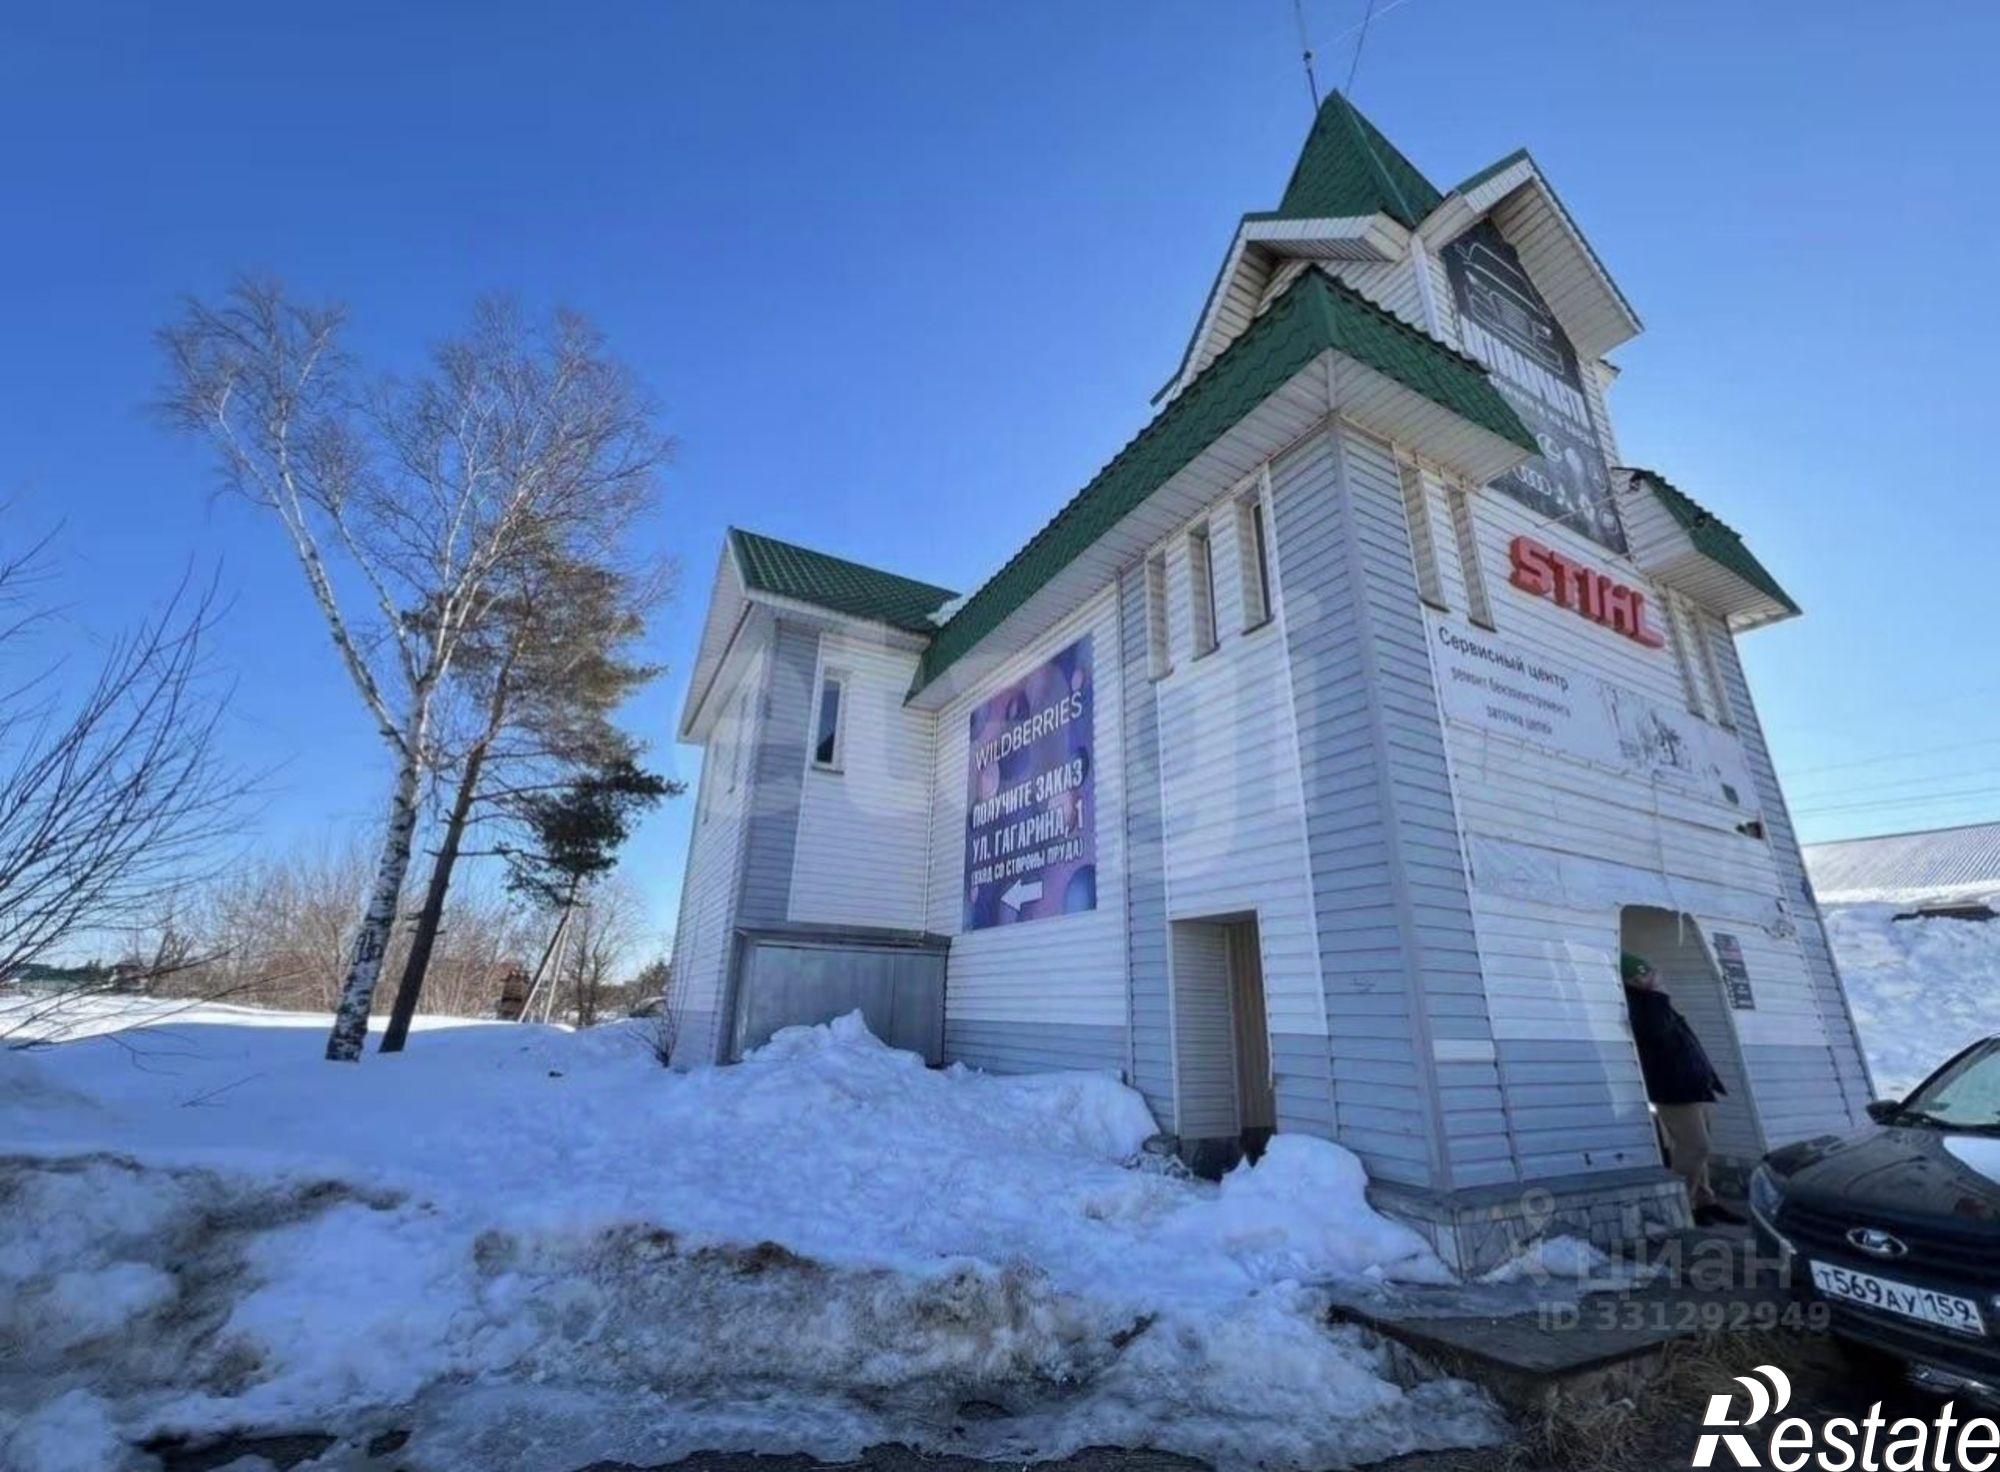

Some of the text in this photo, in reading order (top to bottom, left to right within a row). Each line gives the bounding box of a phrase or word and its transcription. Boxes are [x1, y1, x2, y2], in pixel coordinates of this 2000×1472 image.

[1510, 536, 1664, 648] STIHL
[1439, 626, 1568, 692] Сервисный центр
[975, 692, 1083, 771] WILDBERRIES
[973, 758, 1083, 829] ПОЛУЧИТЕ ЗАКАЗ
[972, 798, 1084, 864] УЛ. ГАГАРИНА, 1
